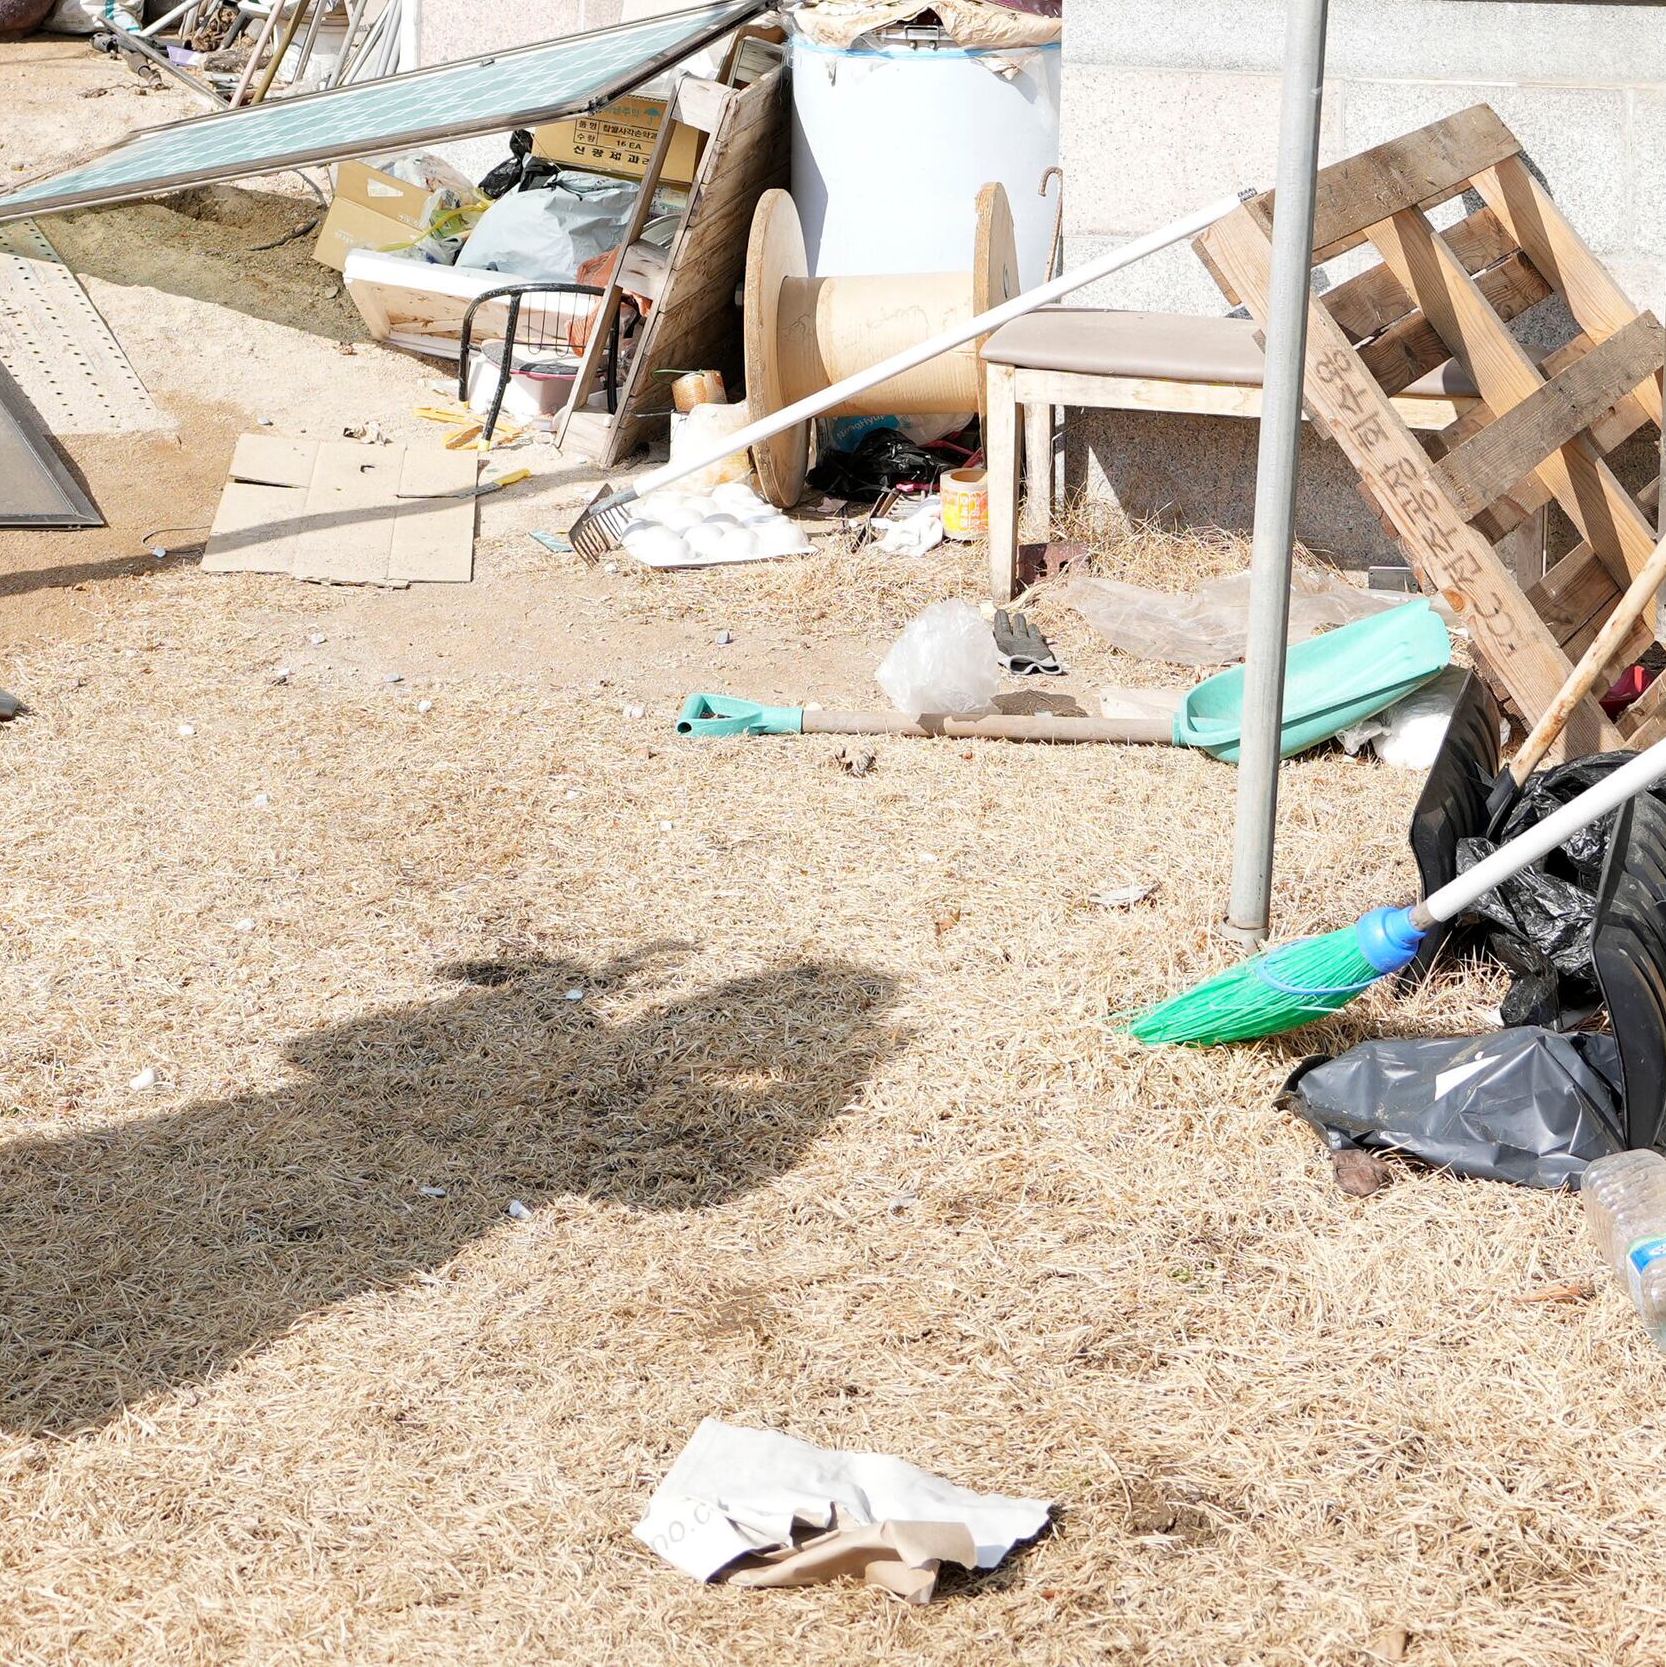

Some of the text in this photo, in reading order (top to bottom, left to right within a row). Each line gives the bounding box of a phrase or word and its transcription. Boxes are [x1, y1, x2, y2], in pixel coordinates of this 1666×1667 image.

[616, 139, 642, 151] 16 EA
[1383, 455, 1483, 592] 전주공장
